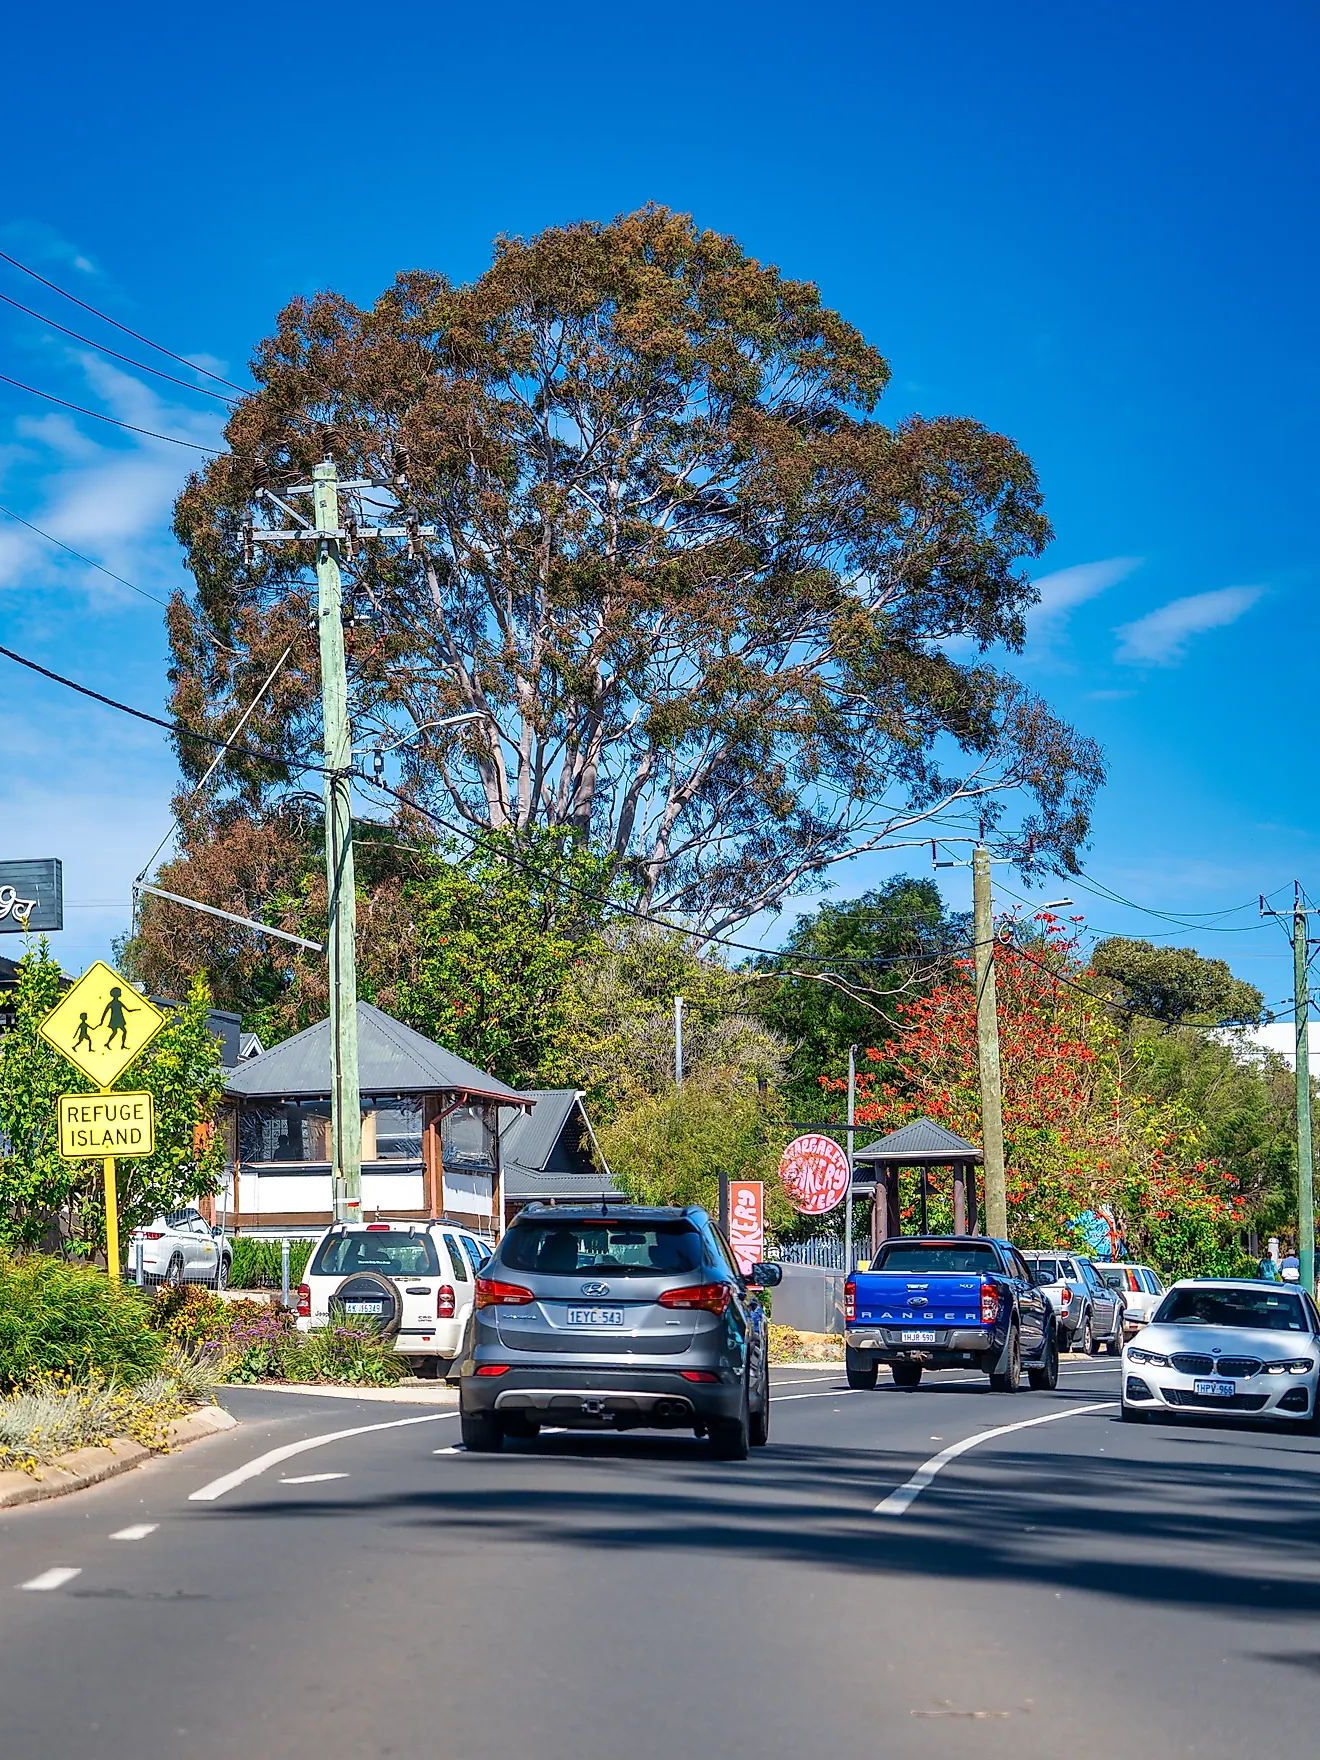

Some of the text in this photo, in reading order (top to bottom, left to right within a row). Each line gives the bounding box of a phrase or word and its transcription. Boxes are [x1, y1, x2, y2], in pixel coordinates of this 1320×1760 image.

[68, 1103, 144, 1122] REFUGE
[71, 1128, 142, 1146] ISLAND
[861, 1312, 976, 1320] RANGER
